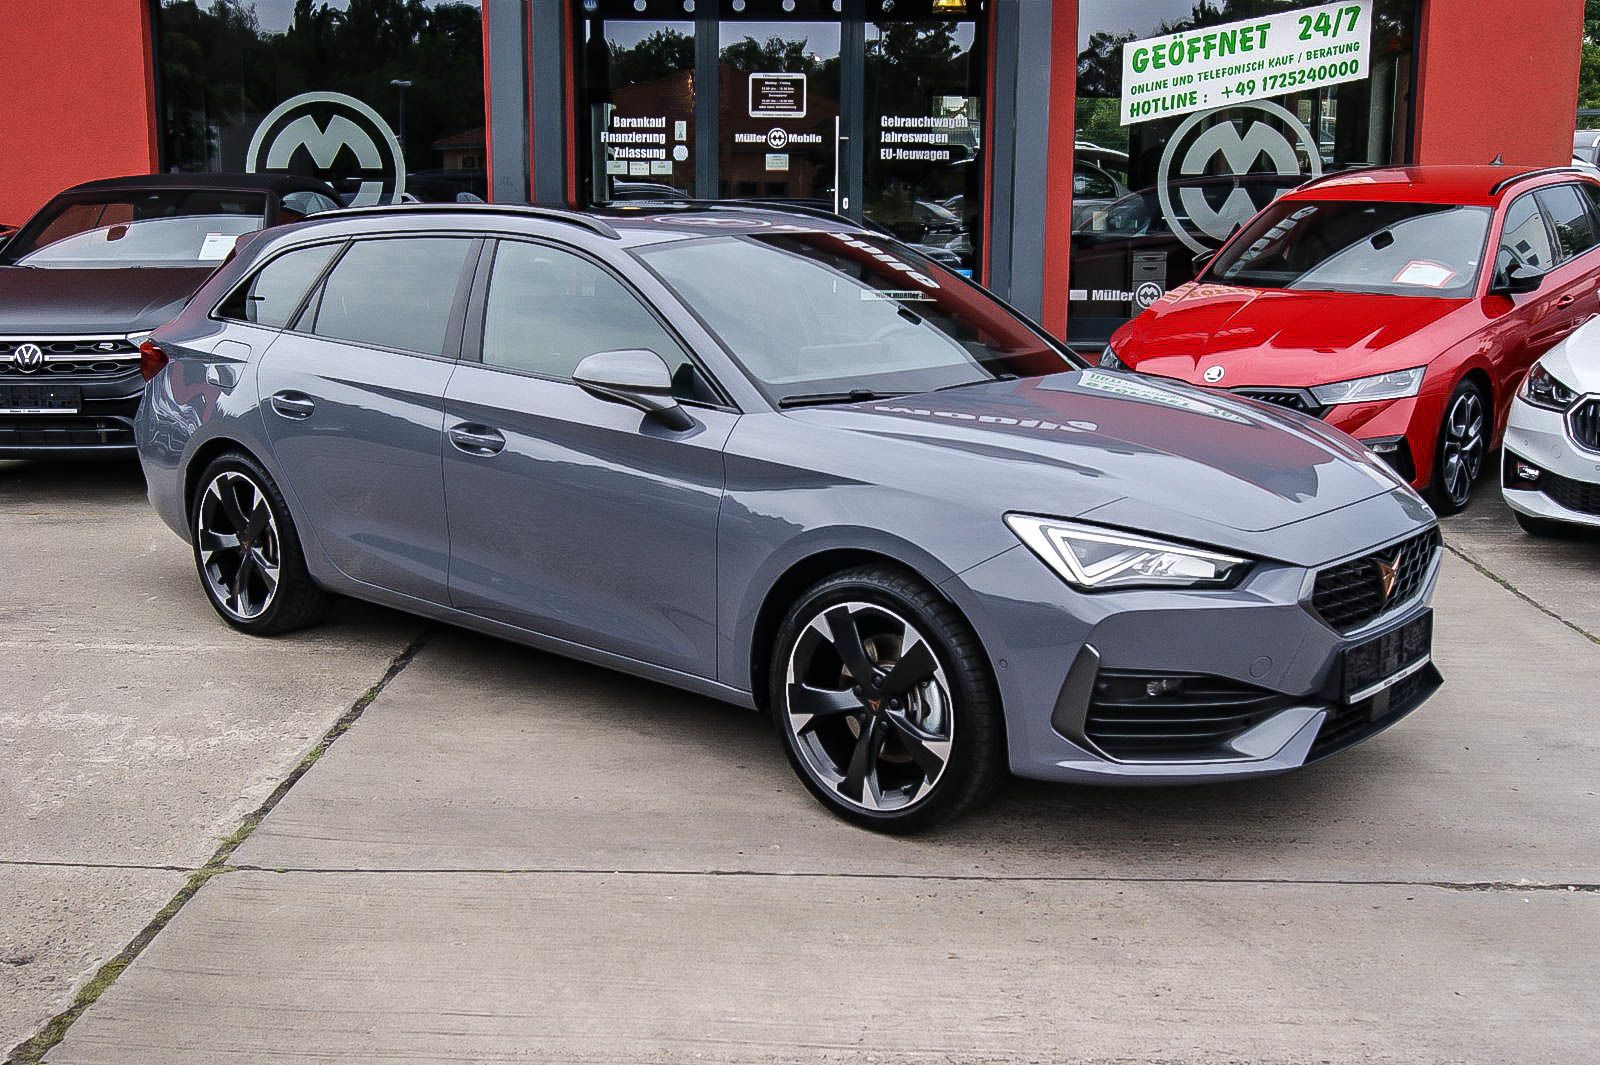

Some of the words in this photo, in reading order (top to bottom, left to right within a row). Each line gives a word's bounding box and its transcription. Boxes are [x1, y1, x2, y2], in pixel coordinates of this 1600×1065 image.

[1132, 23, 1271, 73] GEÖFFNET
[1298, 5, 1361, 40] 24/7
[1130, 79, 1169, 96] ONLINE
[1172, 74, 1194, 87] UND
[1197, 60, 1265, 82] TELEFONISCH
[1268, 54, 1295, 69] KAUF
[1306, 42, 1361, 61] BERATUNG
[1129, 90, 1198, 118] HOTLINE
[1221, 80, 1256, 99] +49
[1262, 59, 1360, 92] 1725240000
[613, 116, 666, 128] Barankauf
[881, 115, 969, 129] Gebrauchtwagen
[600, 131, 666, 145] Finanzierung
[735, 133, 766, 143] Müller
[788, 133, 822, 143] Mobile
[880, 131, 949, 145] Jahreswagen
[614, 146, 666, 160] Zulassung
[880, 148, 950, 161] EU-Neuwagen
[1091, 289, 1135, 302] Müller
